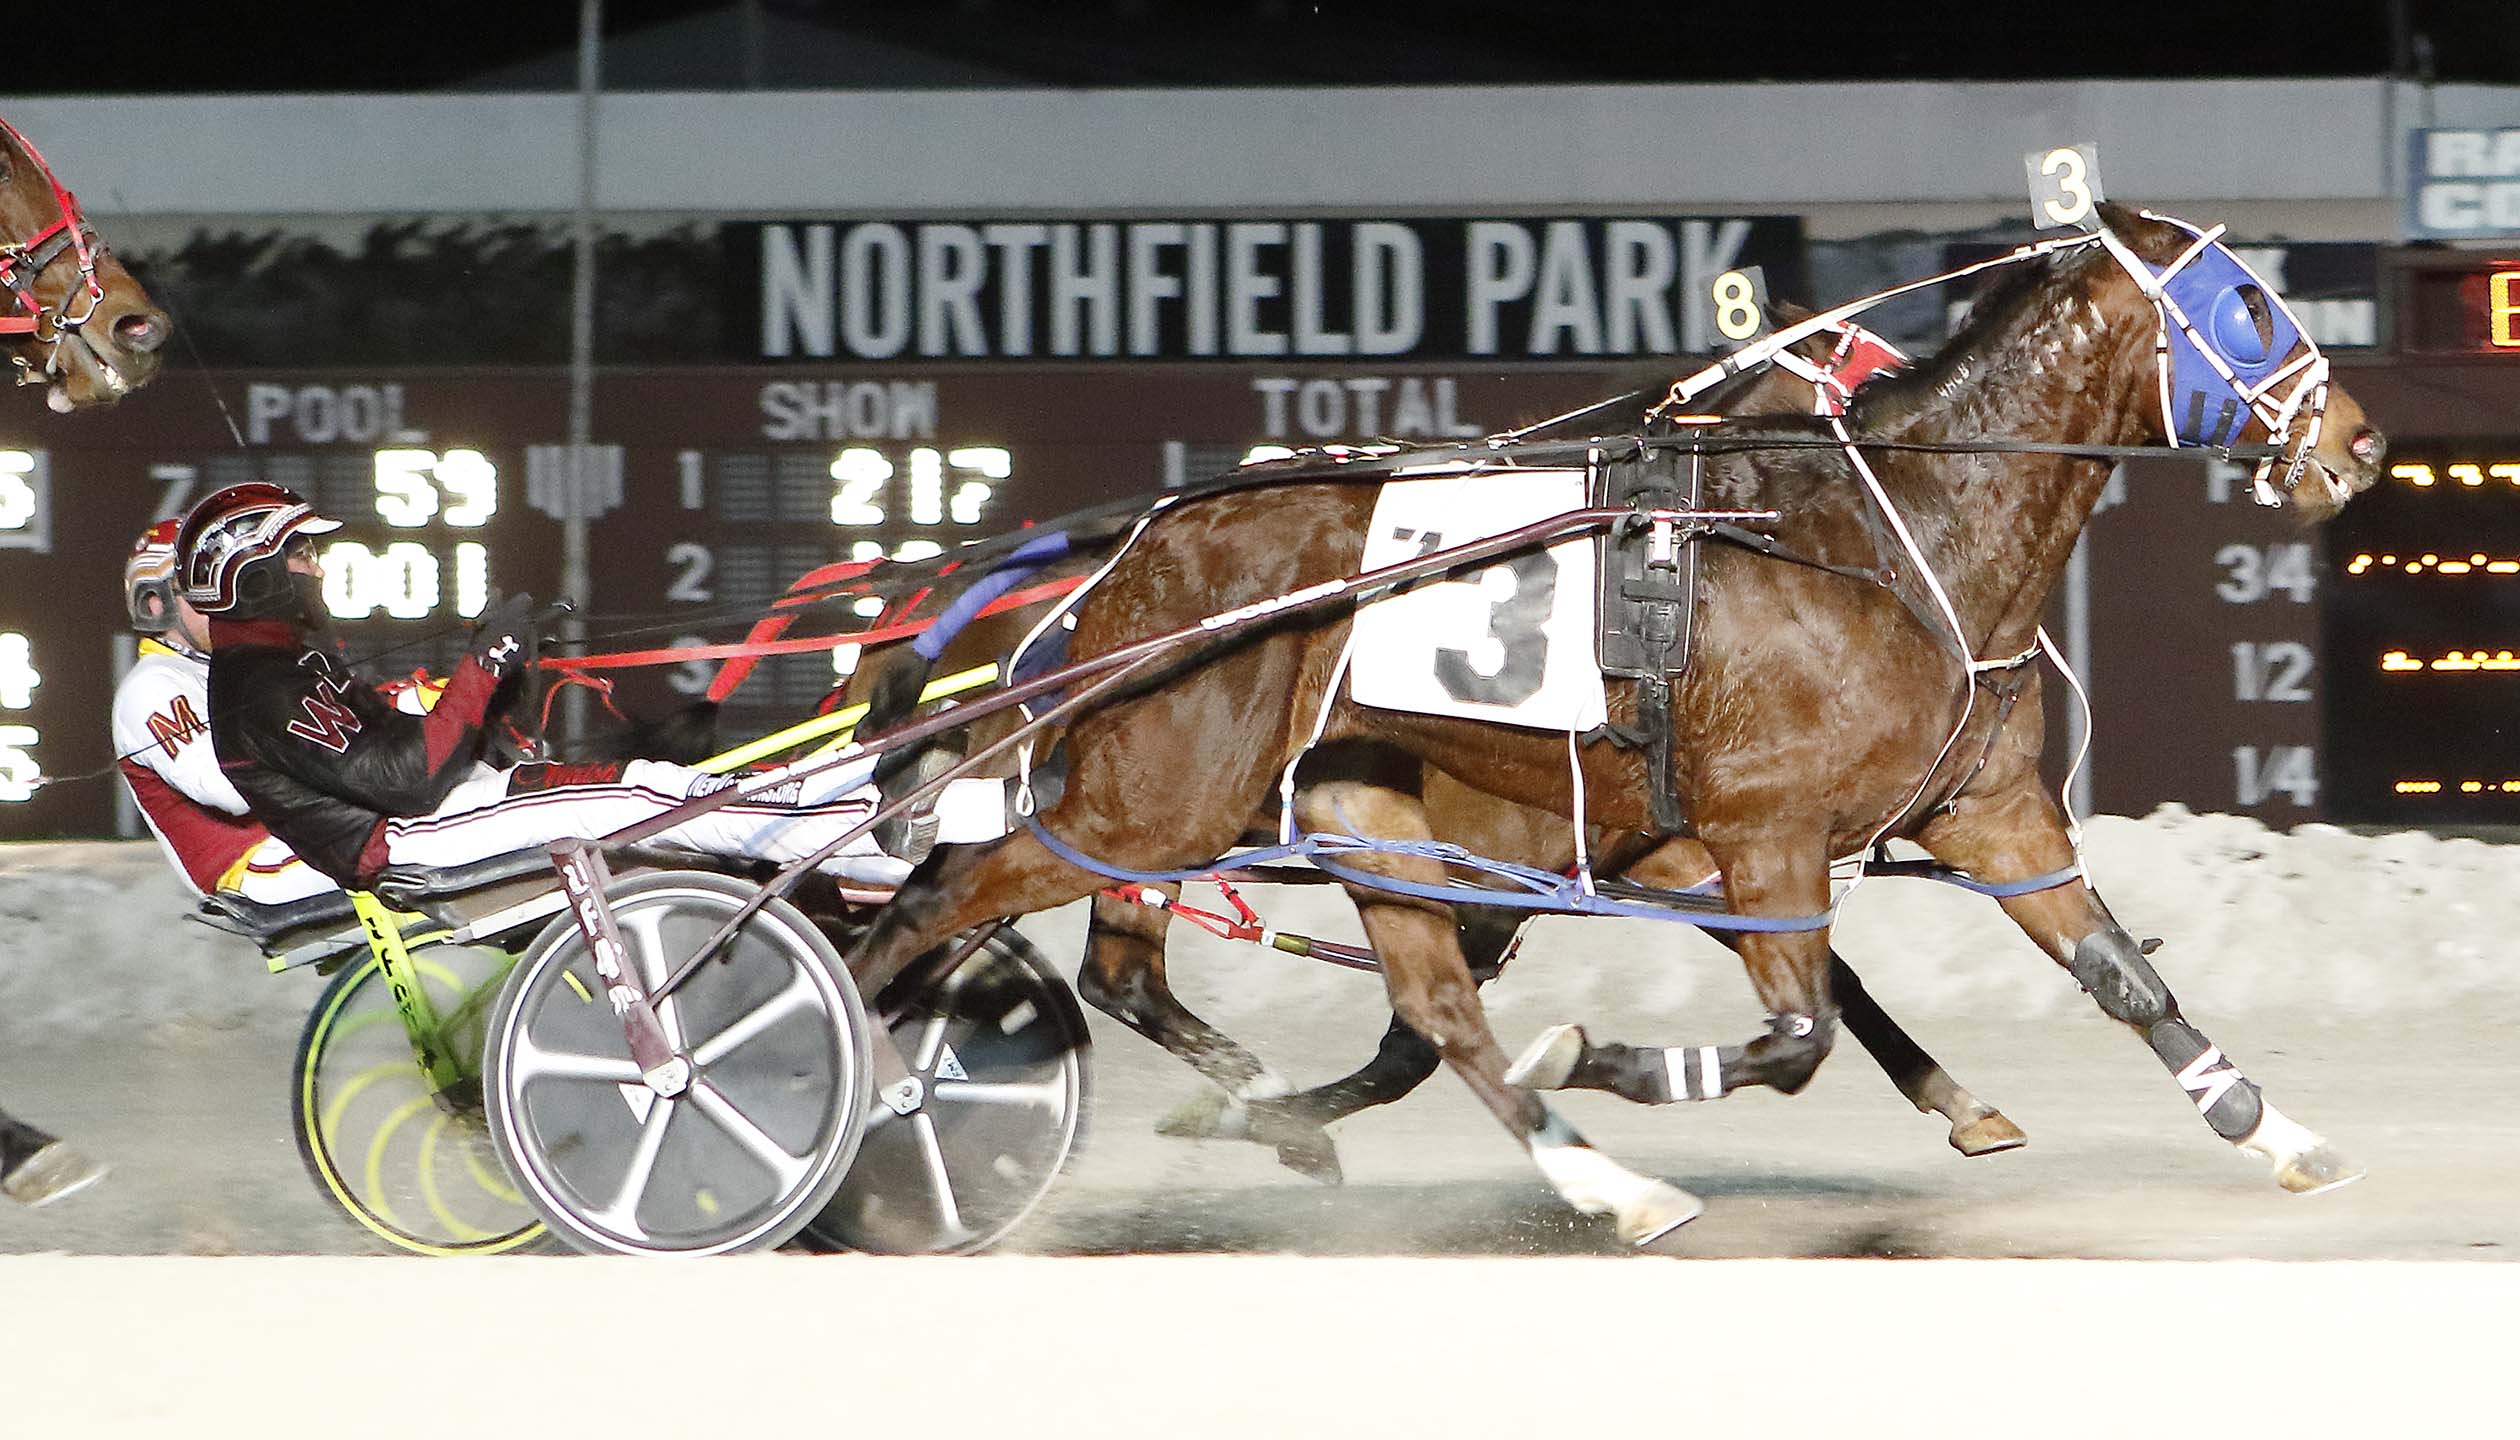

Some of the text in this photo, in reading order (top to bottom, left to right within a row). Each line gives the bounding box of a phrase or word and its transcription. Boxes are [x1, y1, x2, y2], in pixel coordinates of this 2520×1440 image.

[2040, 147, 2092, 225] 3
[761, 219, 1753, 358] NORTHFIELD PARK
[1711, 271, 1762, 341] 8
[249, 384, 430, 445] POOL
[760, 381, 938, 441] SHOW
[1254, 377, 1482, 438] TOTAL
[375, 448, 498, 528] 59
[679, 451, 704, 510] 1
[829, 447, 1012, 525] 217
[666, 541, 713, 602] 2
[1433, 547, 1559, 709] 3
[145, 694, 208, 762] M
